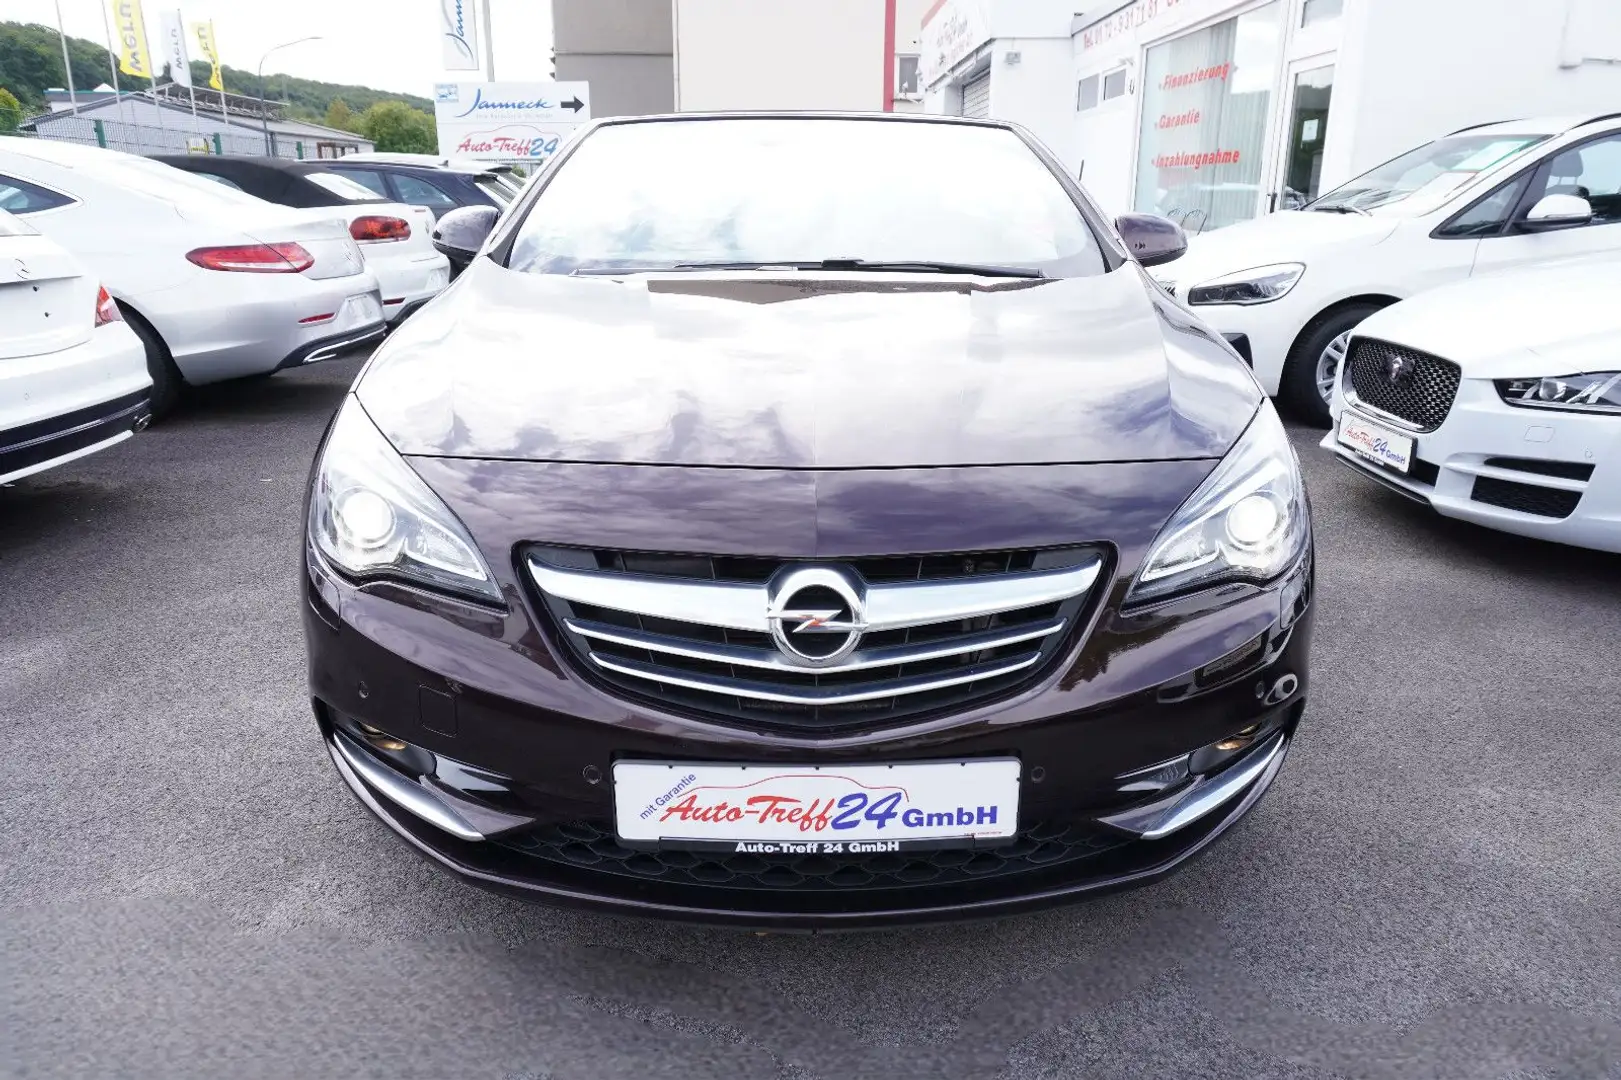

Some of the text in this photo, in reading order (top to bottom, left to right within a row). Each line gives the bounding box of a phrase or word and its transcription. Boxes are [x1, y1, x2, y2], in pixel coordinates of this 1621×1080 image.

[1163, 61, 1230, 91] Finanzierung
[454, 88, 555, 118] Janneck
[1158, 108, 1200, 130] Garantie
[1155, 147, 1240, 170] Inzahlungnahme
[640, 772, 697, 821] mit Garantie
[902, 806, 998, 828] GmbH
[735, 841, 900, 854] Auto-Treff 24 GmbH
